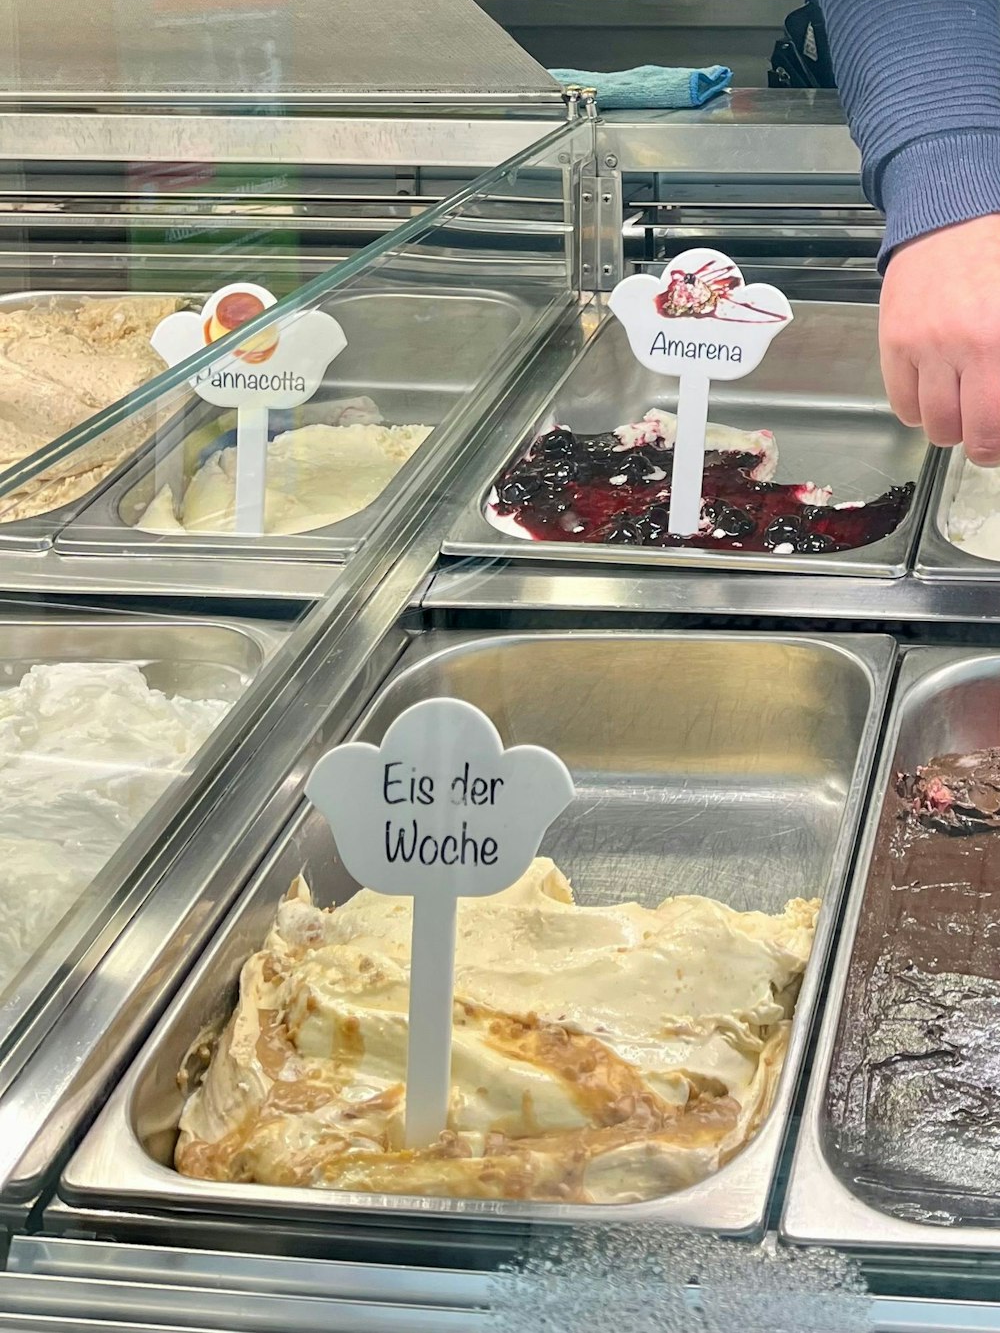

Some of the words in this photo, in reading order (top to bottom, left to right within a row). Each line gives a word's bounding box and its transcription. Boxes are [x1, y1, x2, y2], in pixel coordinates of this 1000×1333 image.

[649, 330, 743, 364] Amarena
[383, 761, 435, 806] Eis
[449, 762, 504, 807] der
[385, 819, 499, 867] Woche
